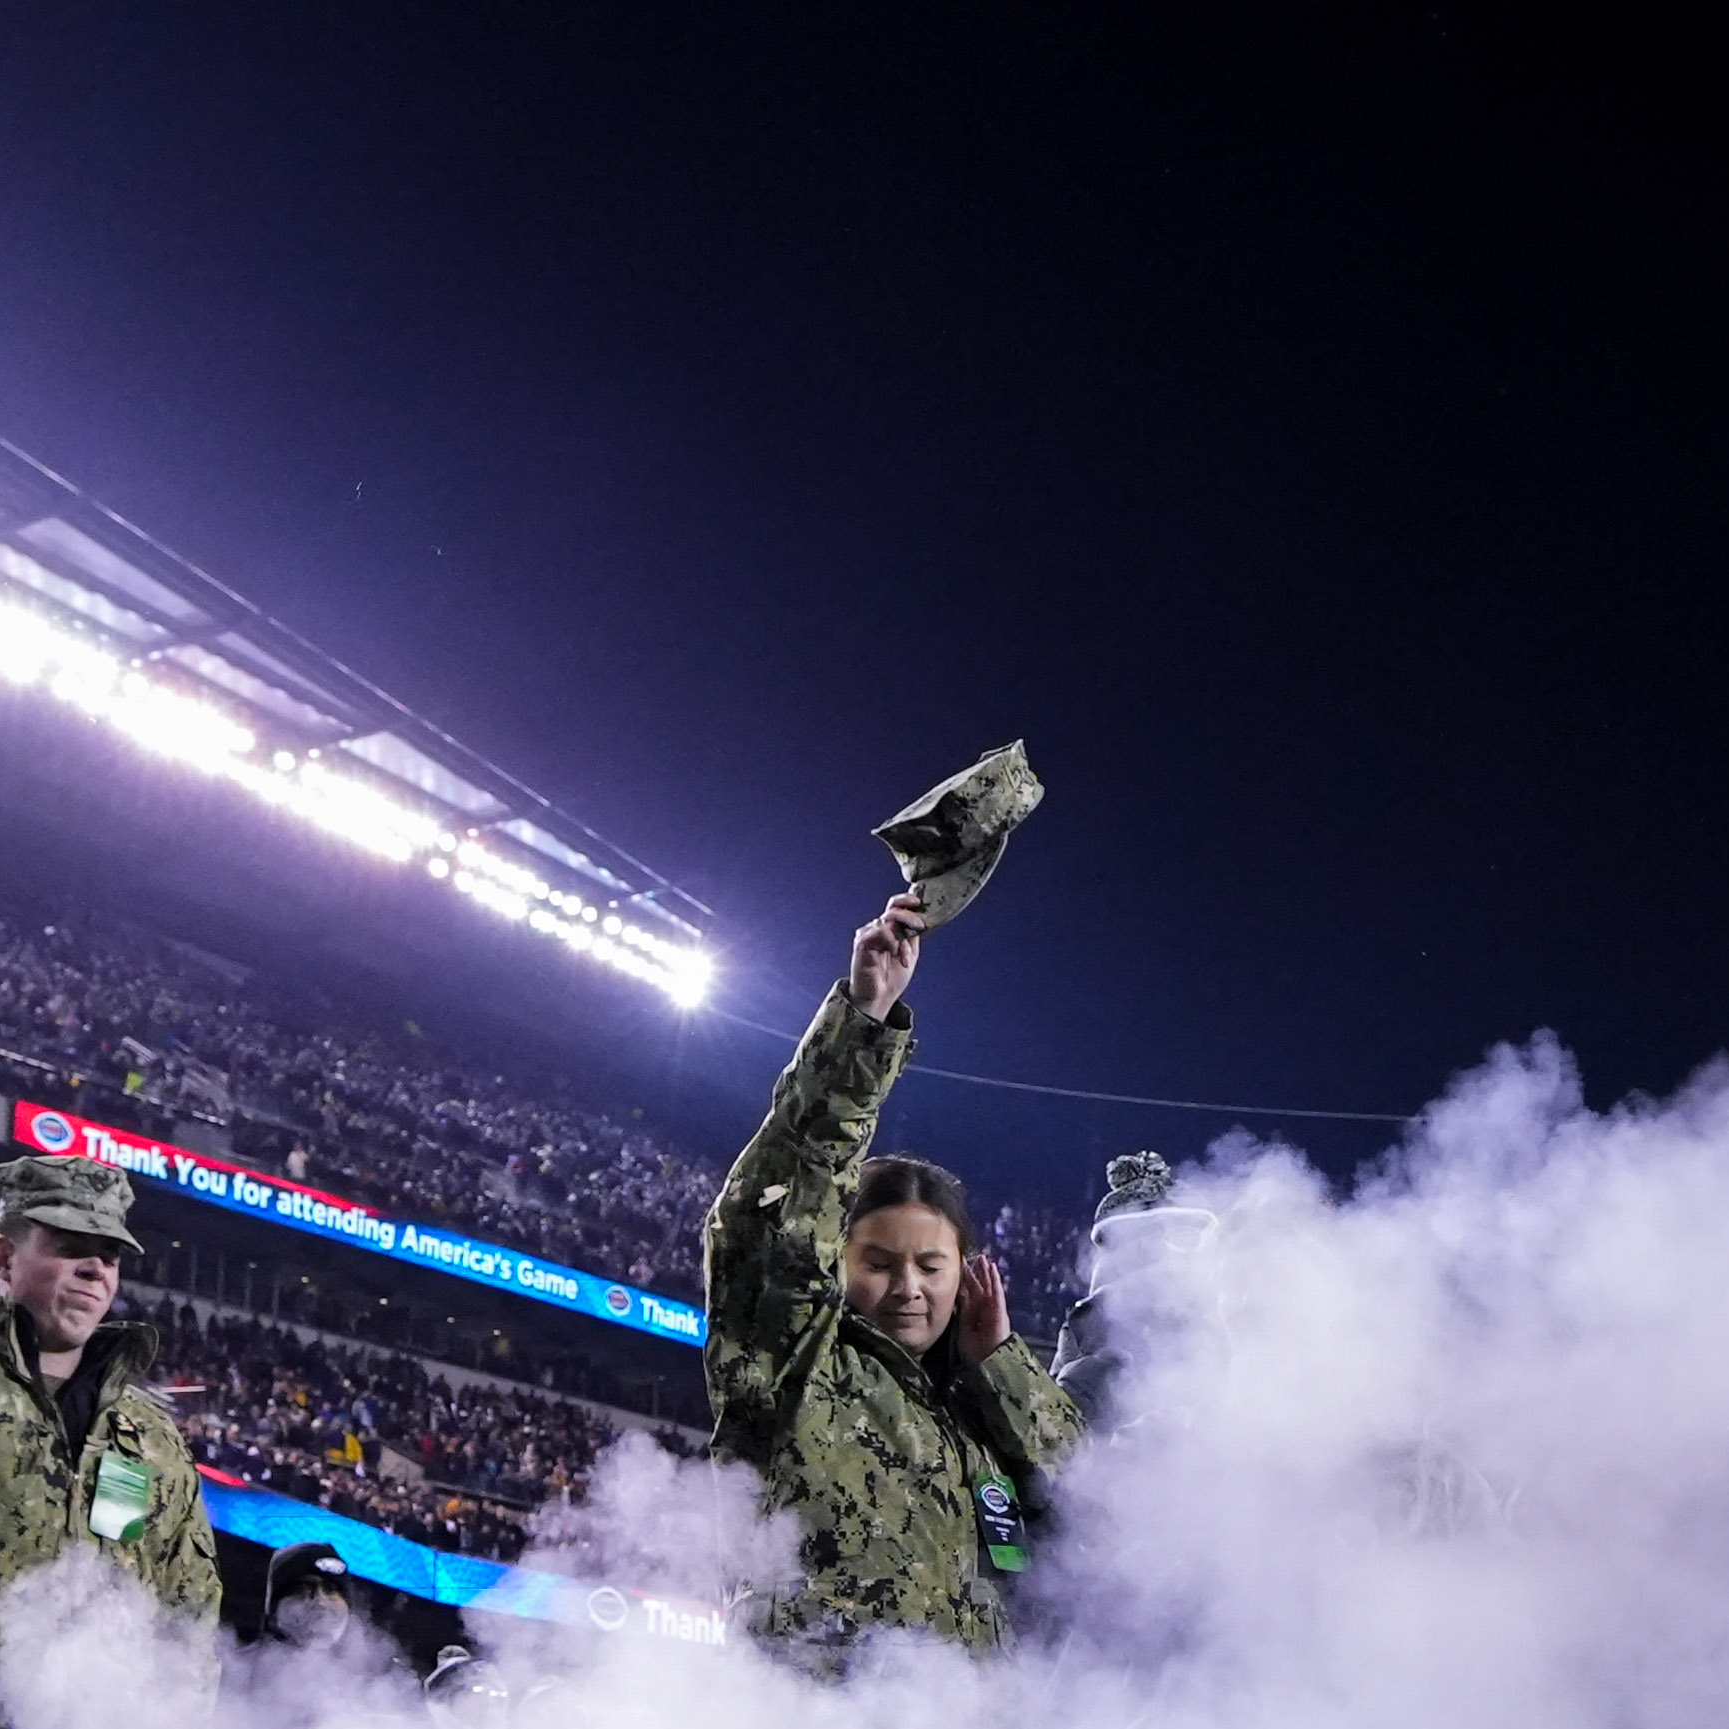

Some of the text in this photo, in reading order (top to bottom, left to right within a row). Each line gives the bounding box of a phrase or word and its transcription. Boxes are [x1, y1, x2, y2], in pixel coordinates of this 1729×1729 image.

[81, 1127, 168, 1179] Thank
[174, 1155, 228, 1197] You
[232, 1172, 273, 1209] for
[276, 1191, 397, 1250] attending
[401, 1225, 512, 1280] America's
[517, 1260, 579, 1299] Game
[640, 1296, 699, 1337] Thank
[642, 1599, 727, 1645] Thank
